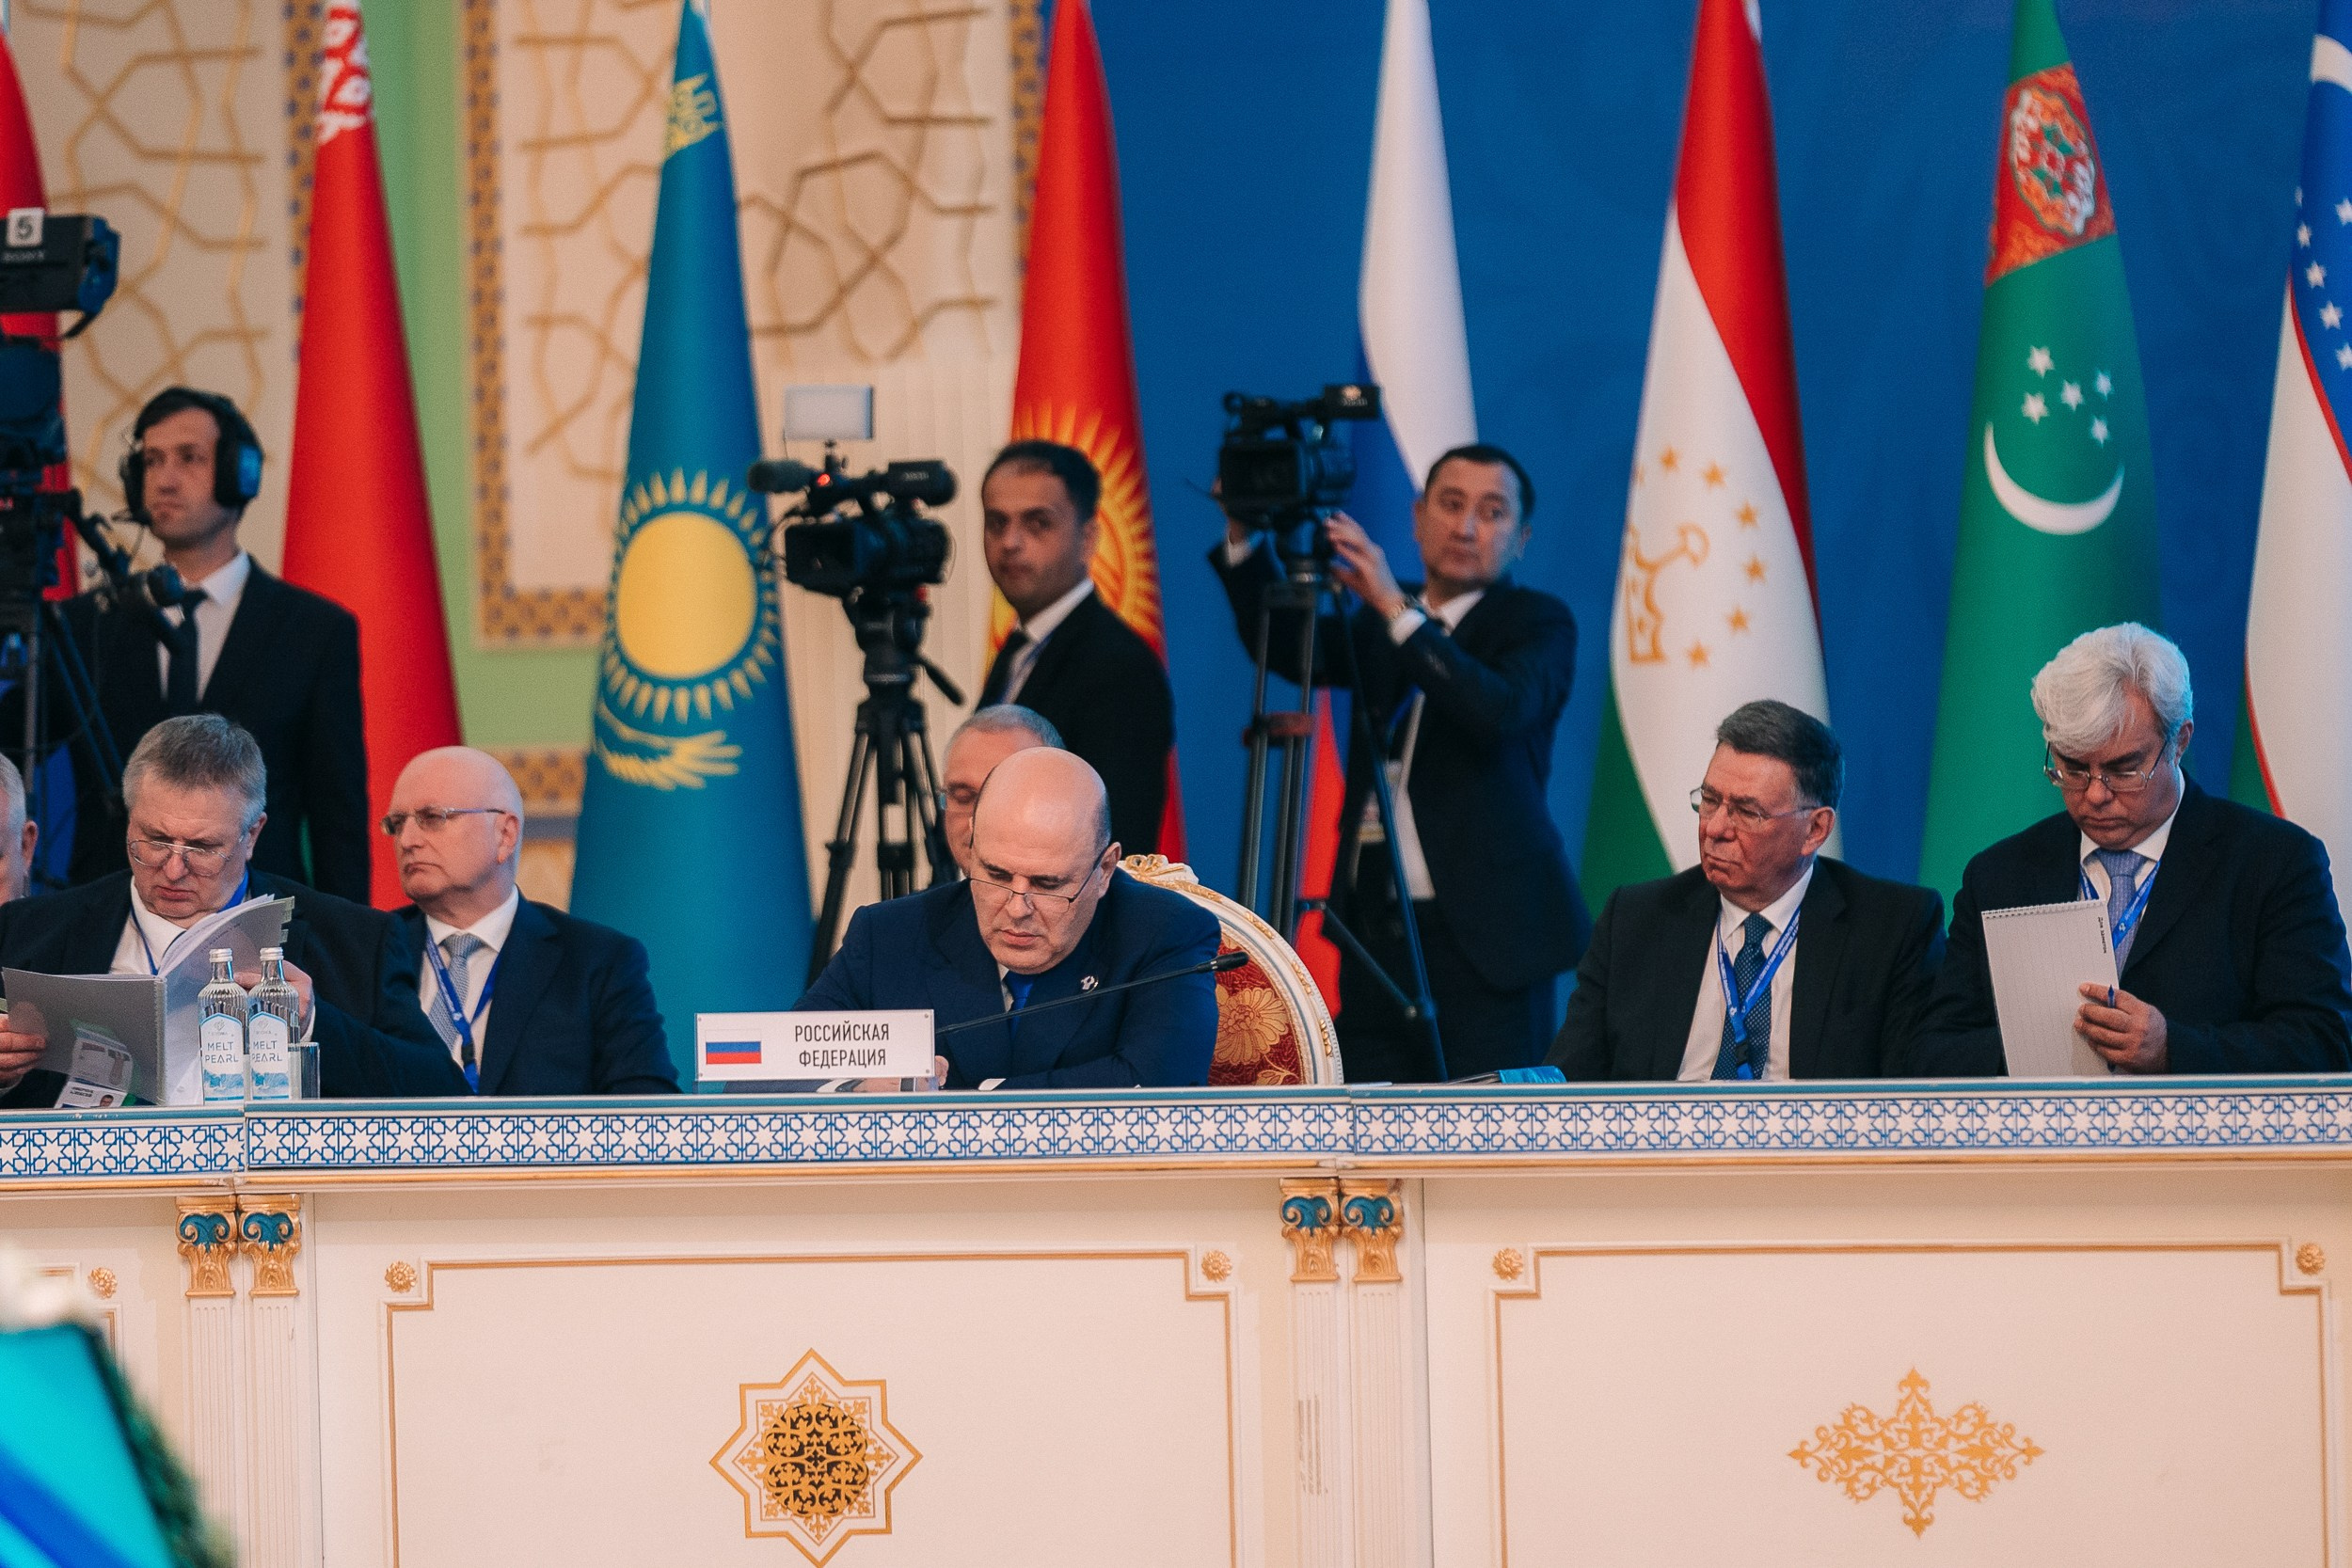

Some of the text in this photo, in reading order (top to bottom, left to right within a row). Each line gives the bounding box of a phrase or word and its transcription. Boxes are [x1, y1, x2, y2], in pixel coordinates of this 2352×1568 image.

[17, 215, 33, 240] 5
[795, 1020, 889, 1042] РОССИЙСКАЯ
[207, 1041, 233, 1052] MELT
[253, 1040, 278, 1050] MELT
[204, 1053, 239, 1064] PEARL
[251, 1053, 282, 1063] PEARL
[799, 1049, 886, 1069] ФЕДЕРАЦИЯ
